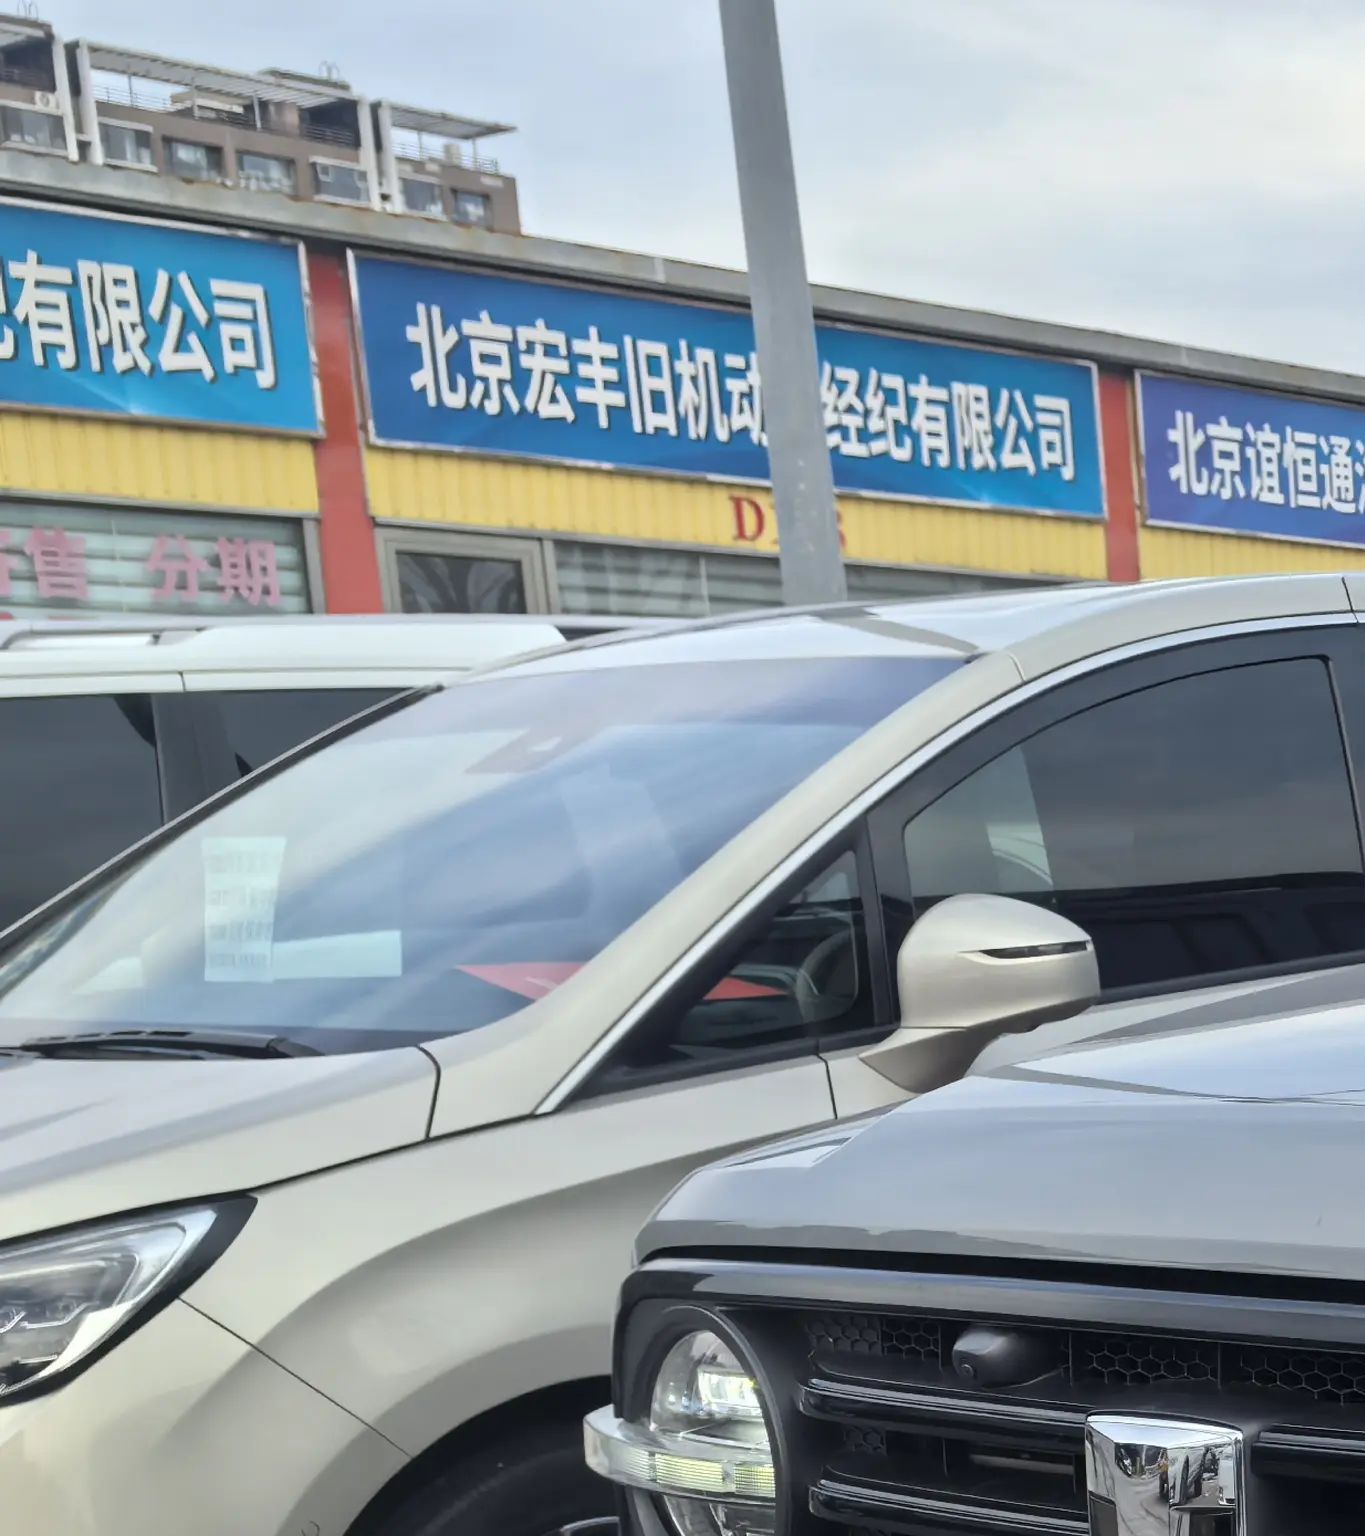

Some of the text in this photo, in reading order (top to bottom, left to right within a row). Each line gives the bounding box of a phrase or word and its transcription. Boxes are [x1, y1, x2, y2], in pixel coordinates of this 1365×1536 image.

[0, 249, 275, 389] 有限公司
[405, 302, 1075, 481] 北京宏丰旧机动经纪有限公司
[0, 527, 281, 607] 售 分期
